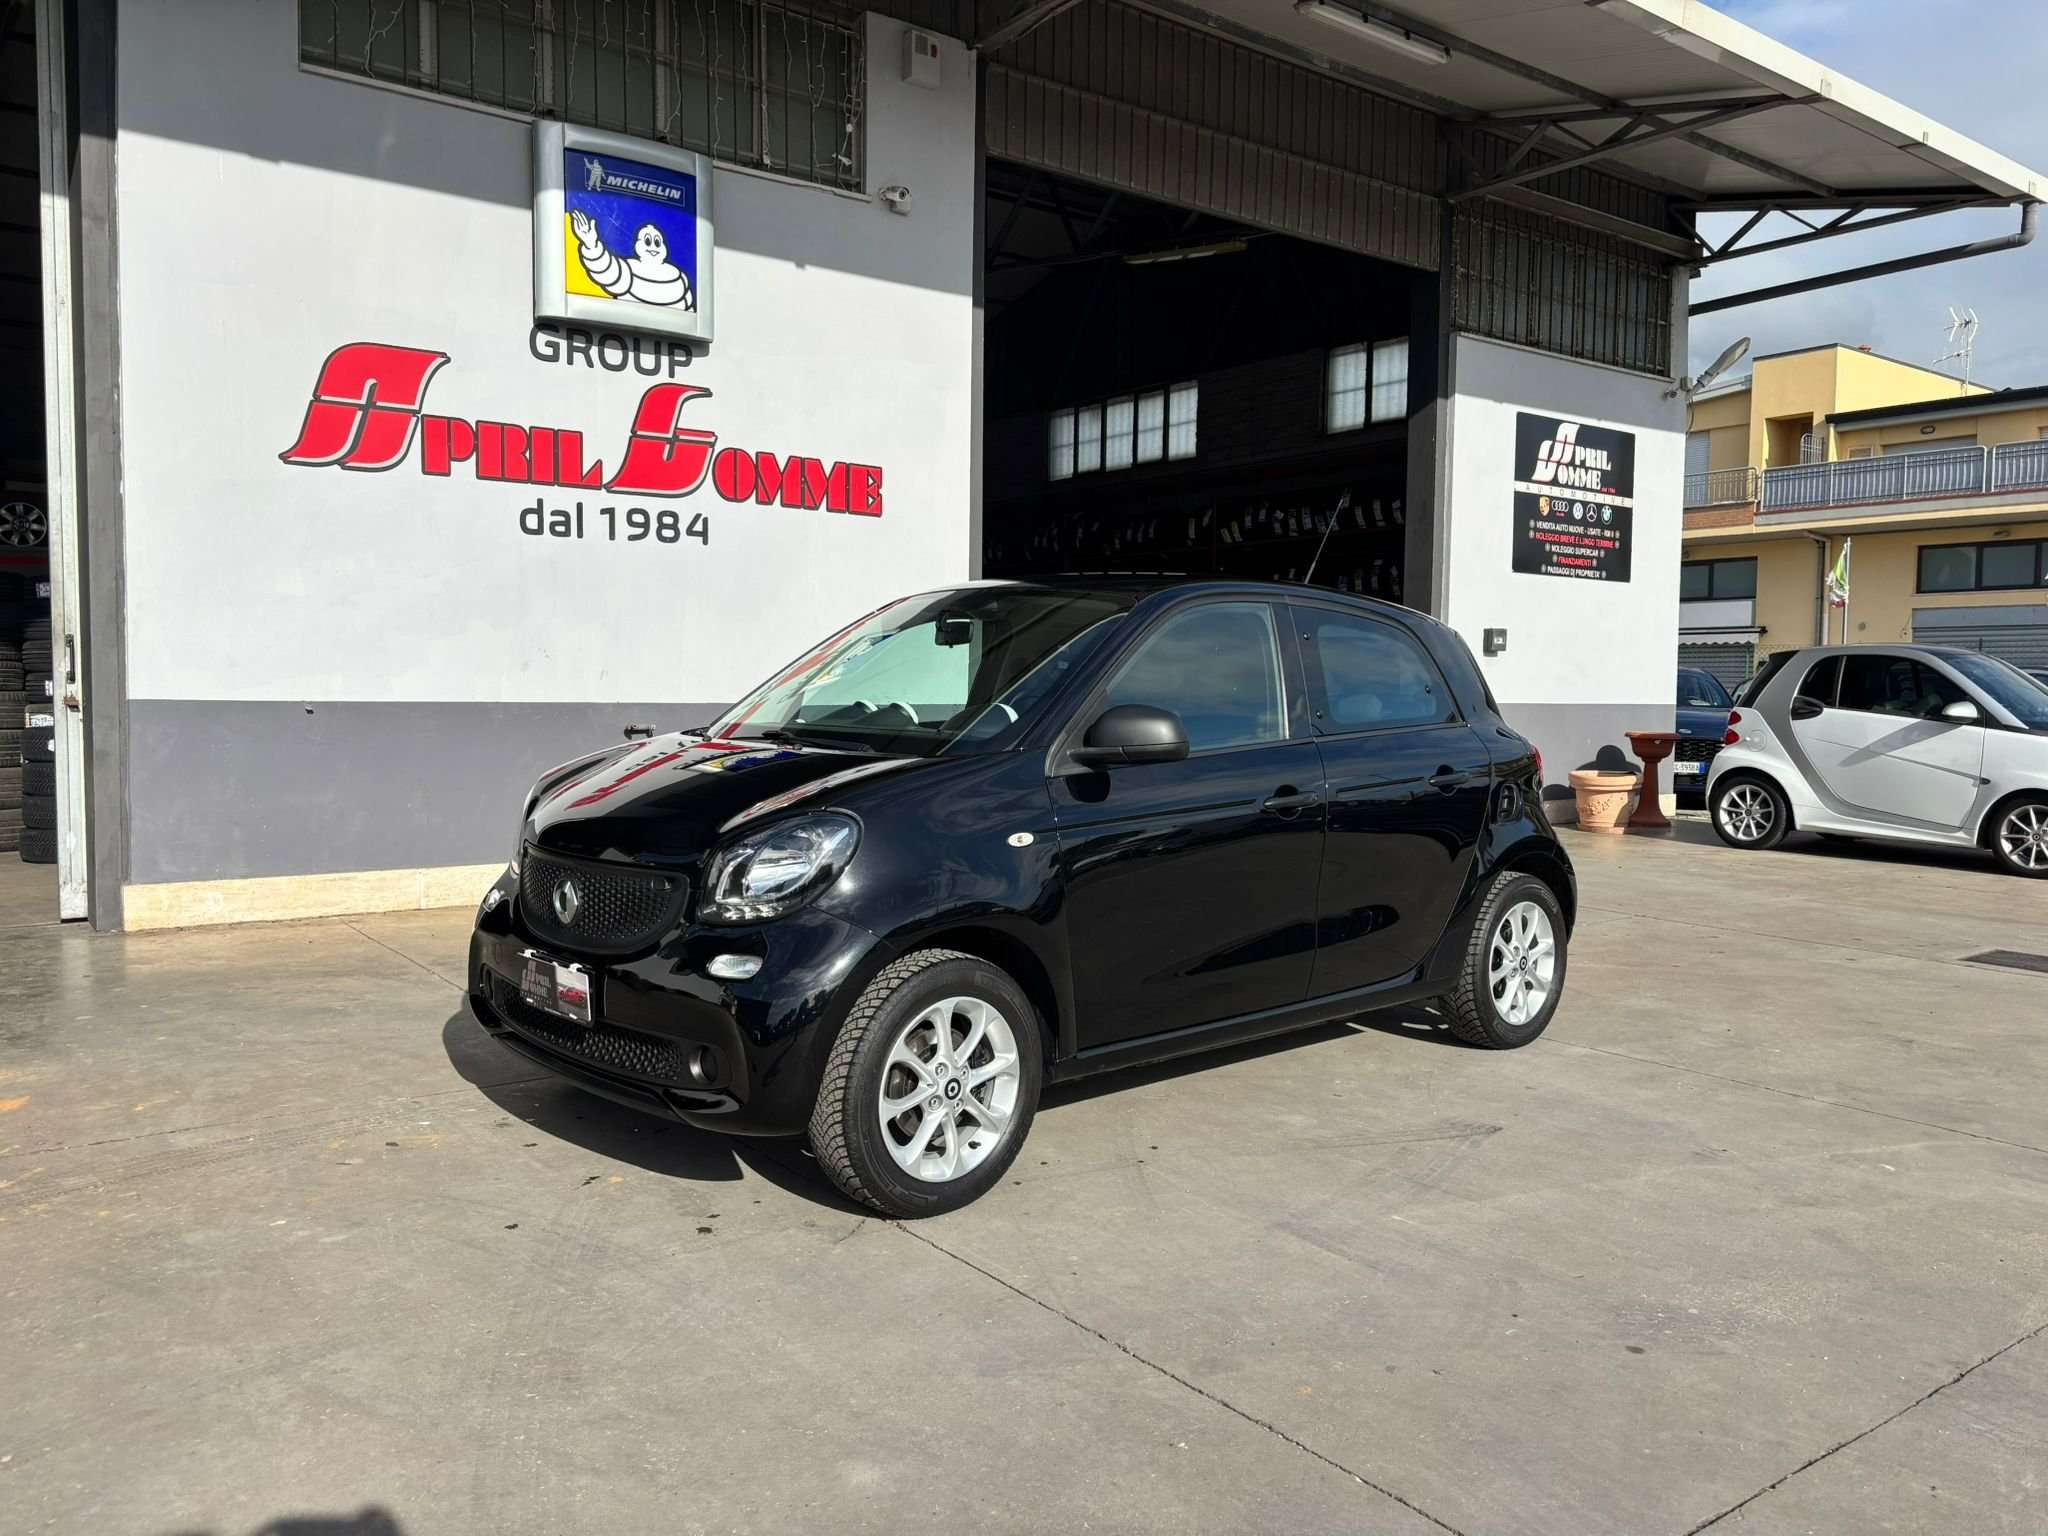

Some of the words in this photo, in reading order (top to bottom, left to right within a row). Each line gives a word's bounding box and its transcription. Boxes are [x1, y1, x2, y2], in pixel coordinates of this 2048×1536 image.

[606, 175, 681, 199] MICHELIN
[529, 324, 693, 379] GROUP
[519, 498, 583, 539] dal
[600, 506, 710, 546] 1984
[1556, 523, 1568, 532] AUTO
